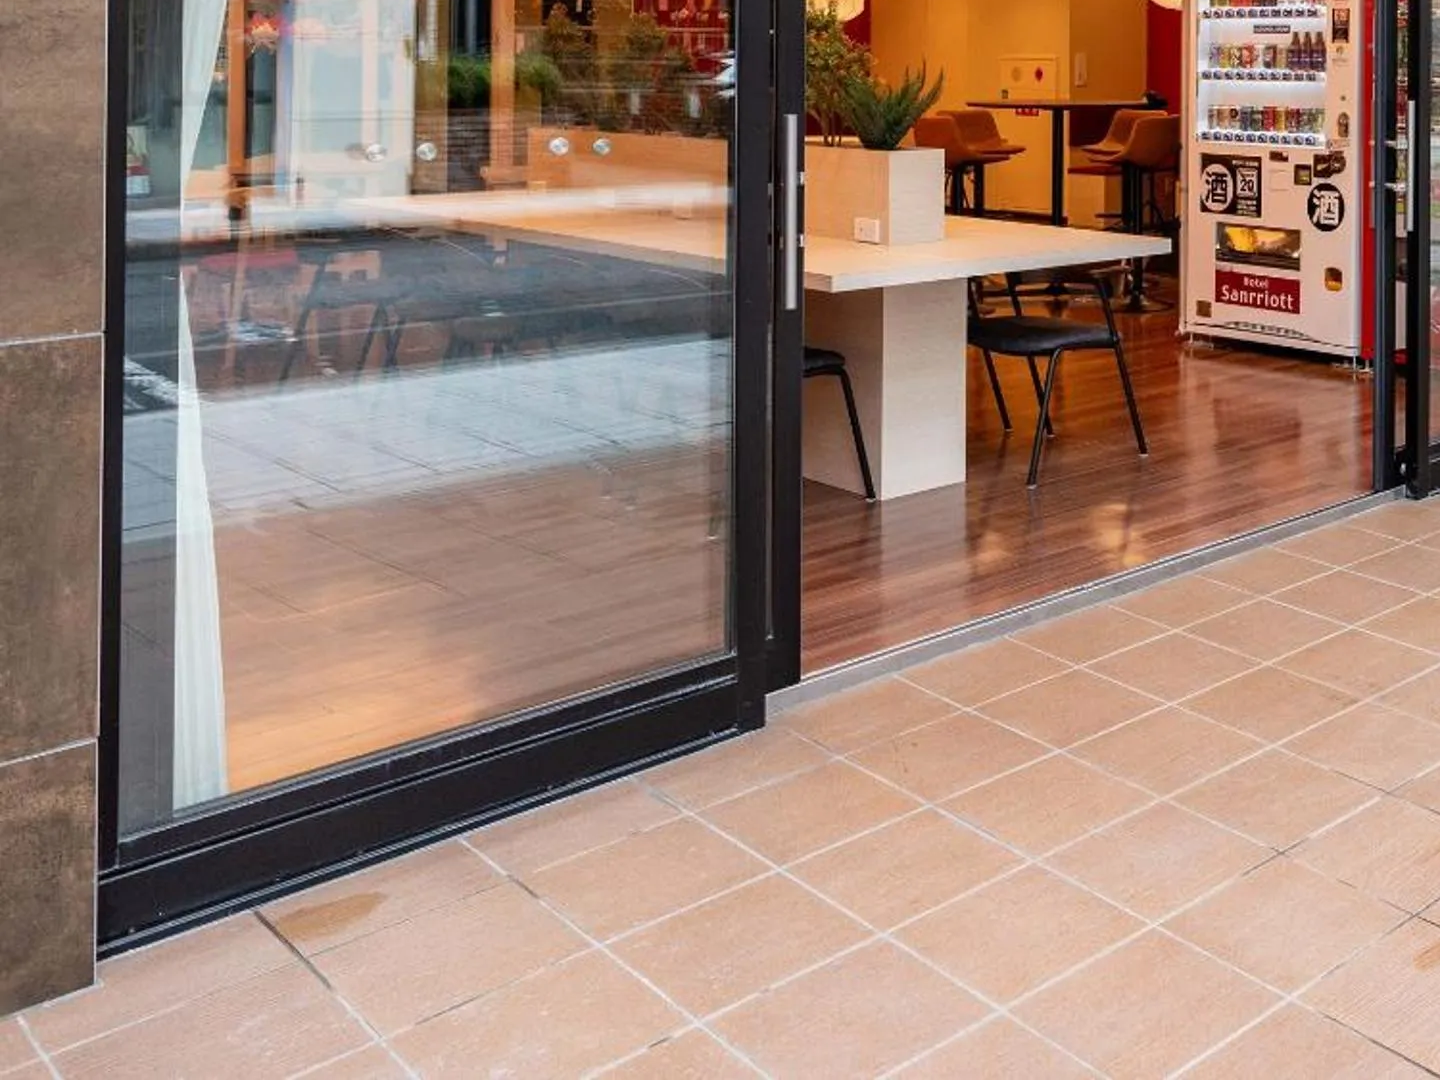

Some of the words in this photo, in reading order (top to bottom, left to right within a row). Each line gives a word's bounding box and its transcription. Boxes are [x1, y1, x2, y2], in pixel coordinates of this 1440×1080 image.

[1205, 171, 1229, 203] 酒
[1312, 187, 1340, 225] 酒
[1221, 284, 1295, 311] Sanrriott
[1243, 277, 1269, 290] Hotel
